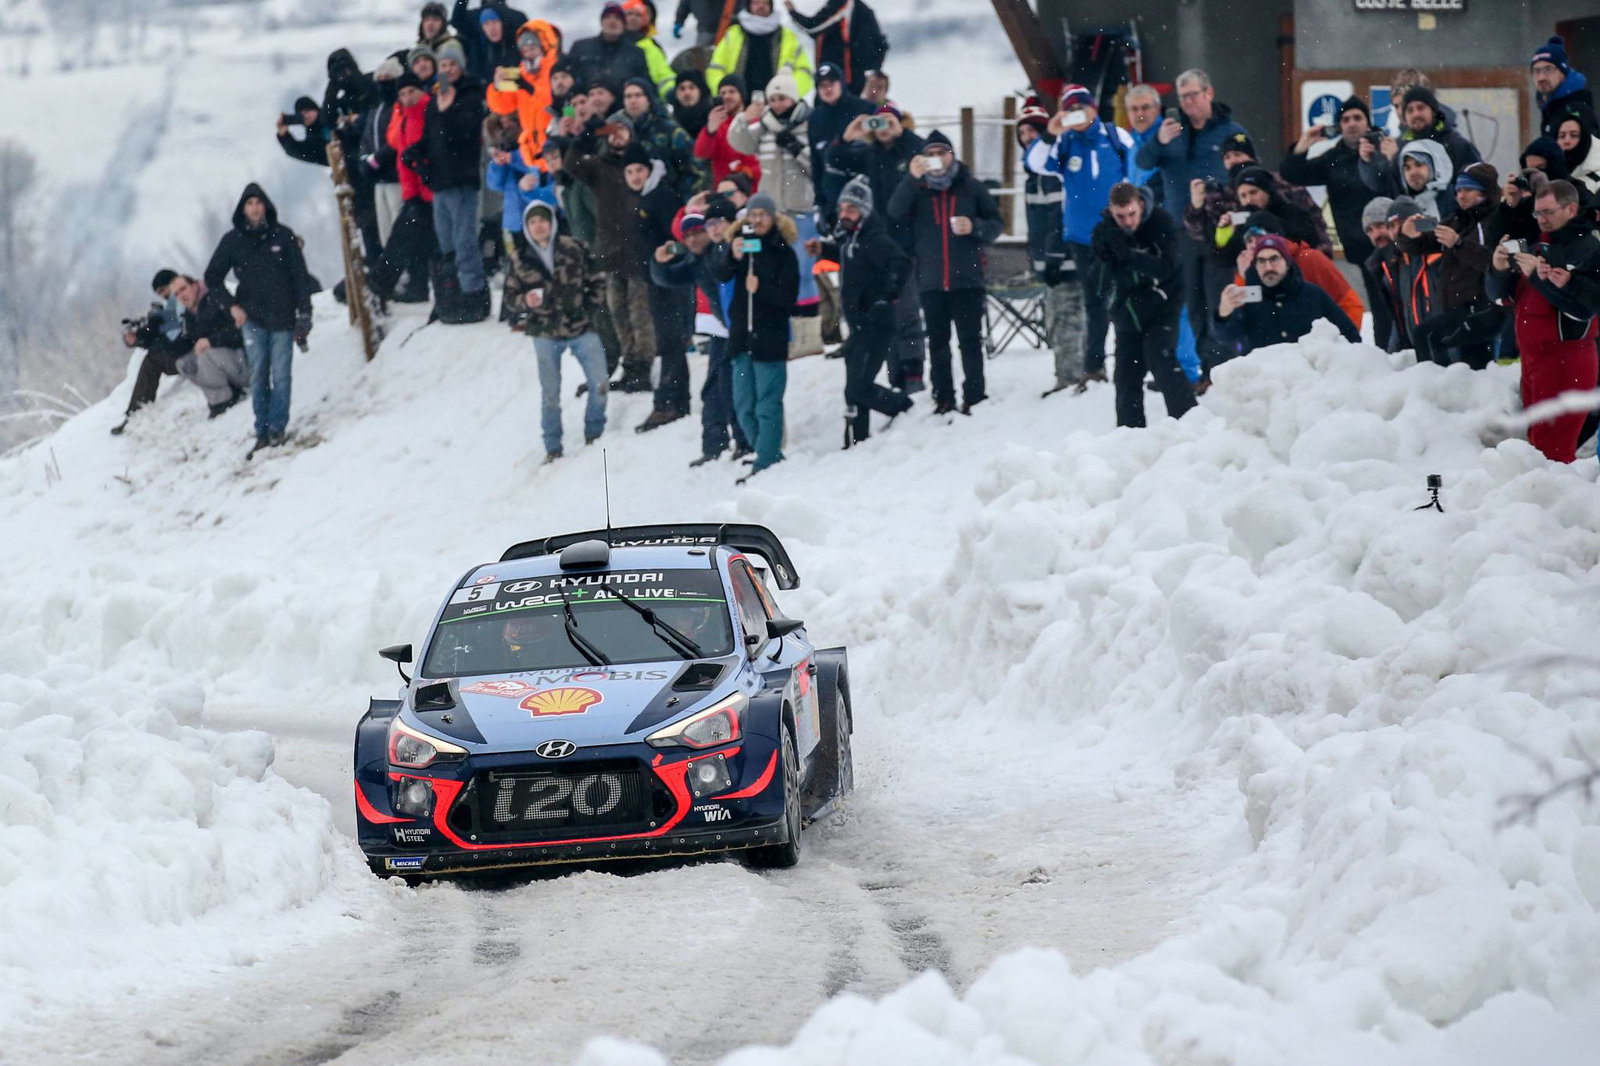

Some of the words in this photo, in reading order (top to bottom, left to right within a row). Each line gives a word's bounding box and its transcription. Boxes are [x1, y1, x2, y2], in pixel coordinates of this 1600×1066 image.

[549, 572, 664, 588] HYUNDAI
[468, 586, 483, 600] 5
[495, 593, 570, 610] WRC
[593, 589, 625, 600] ALL
[634, 588, 675, 598] LIVE
[535, 670, 668, 686] MOBIS
[694, 804, 720, 812] HYUNDAI
